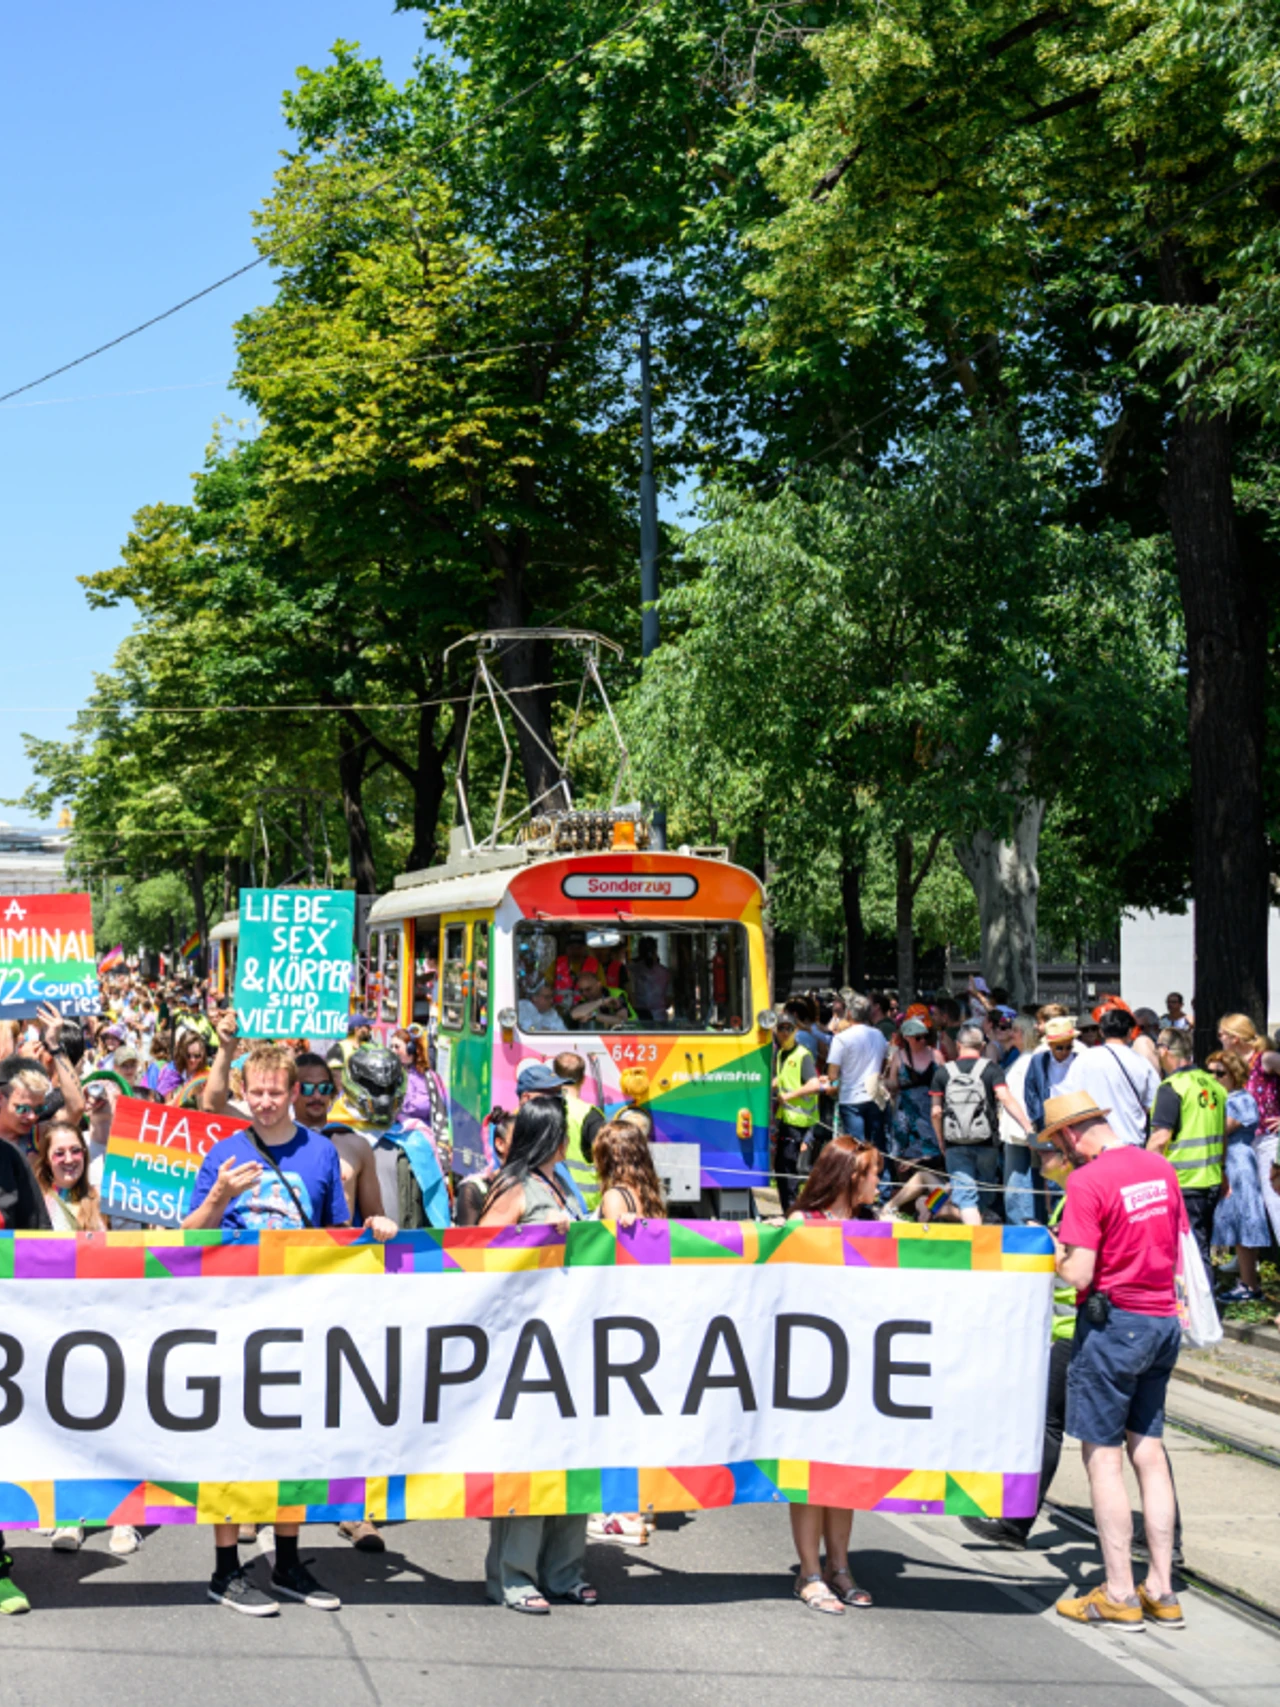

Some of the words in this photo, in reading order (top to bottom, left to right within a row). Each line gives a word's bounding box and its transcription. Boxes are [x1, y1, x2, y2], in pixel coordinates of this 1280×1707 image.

[588, 878, 672, 896] Sonderzug
[3, 899, 27, 922] A
[245, 894, 338, 929] LIEBE,
[271, 926, 332, 955] SEX
[61, 996, 102, 1014] ries
[267, 992, 320, 1010] SIND
[612, 1044, 658, 1062] 6423
[138, 1108, 243, 1158] HAS
